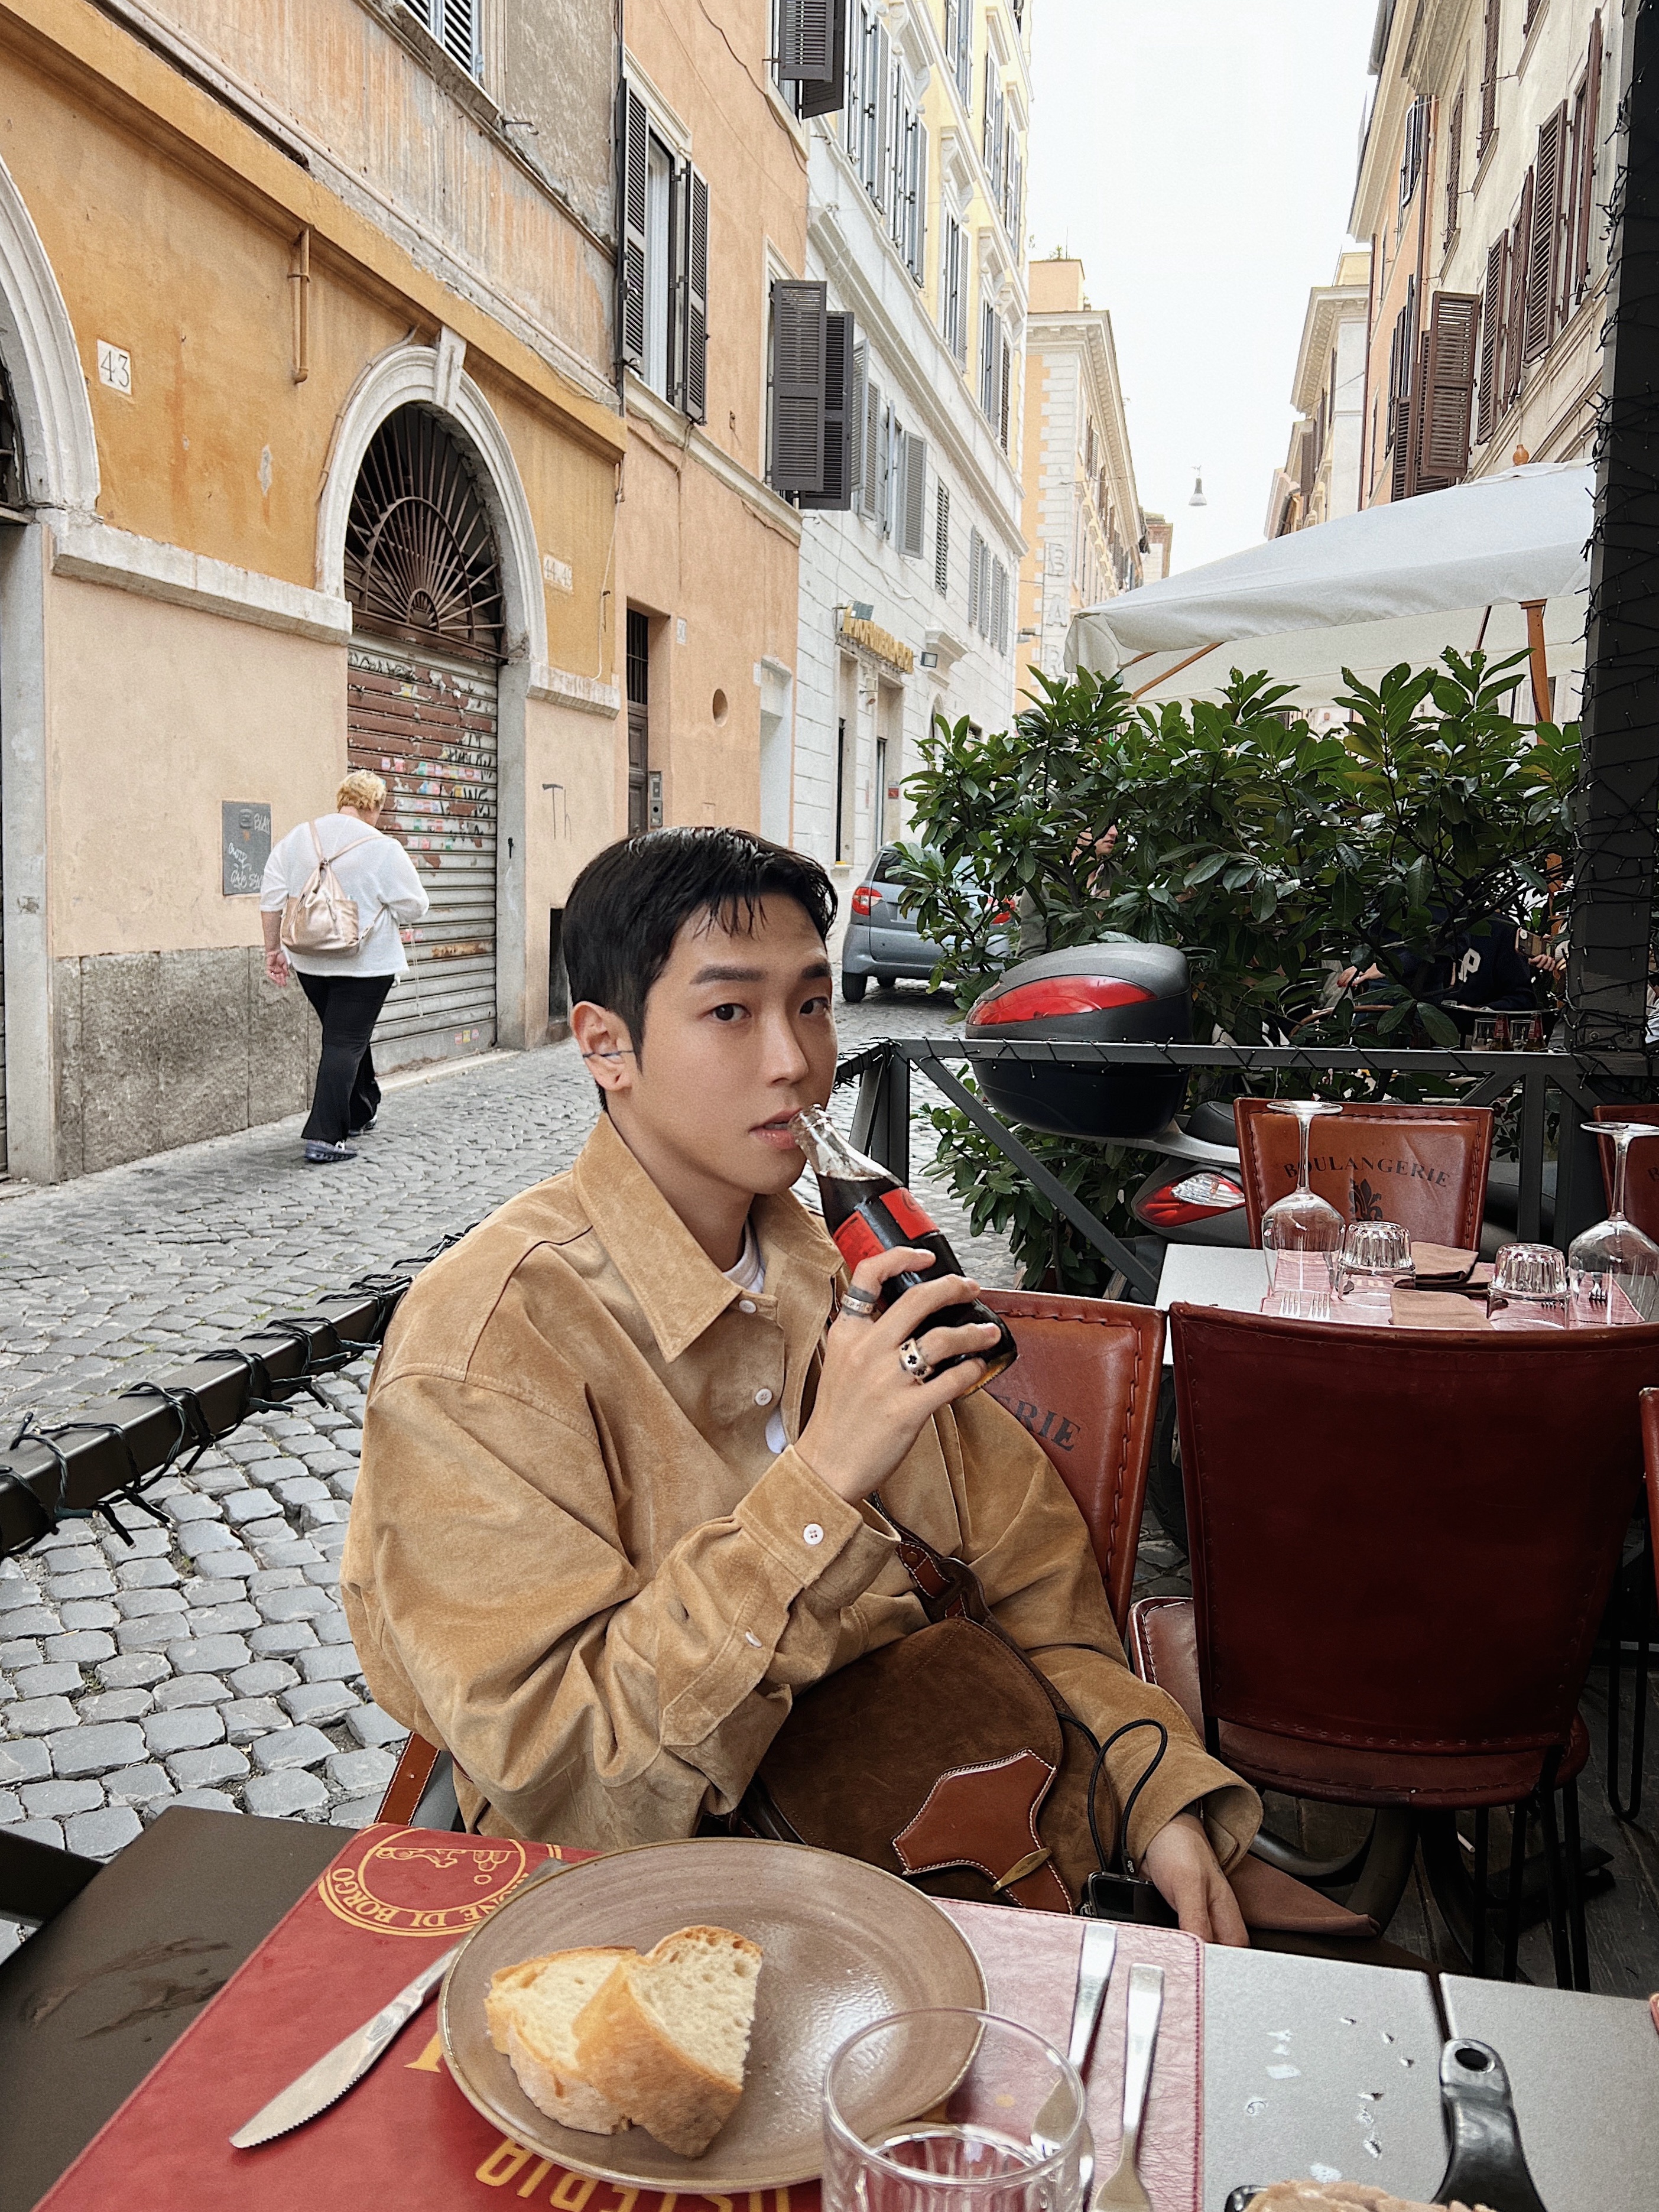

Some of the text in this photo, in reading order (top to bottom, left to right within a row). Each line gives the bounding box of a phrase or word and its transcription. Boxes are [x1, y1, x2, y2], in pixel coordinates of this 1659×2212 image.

[100, 350, 129, 388] 43
[1045, 543, 1068, 678] BAR
[1283, 1156, 1450, 1187] BOULANGERIE
[332, 1867, 447, 1927] DI BORGO
